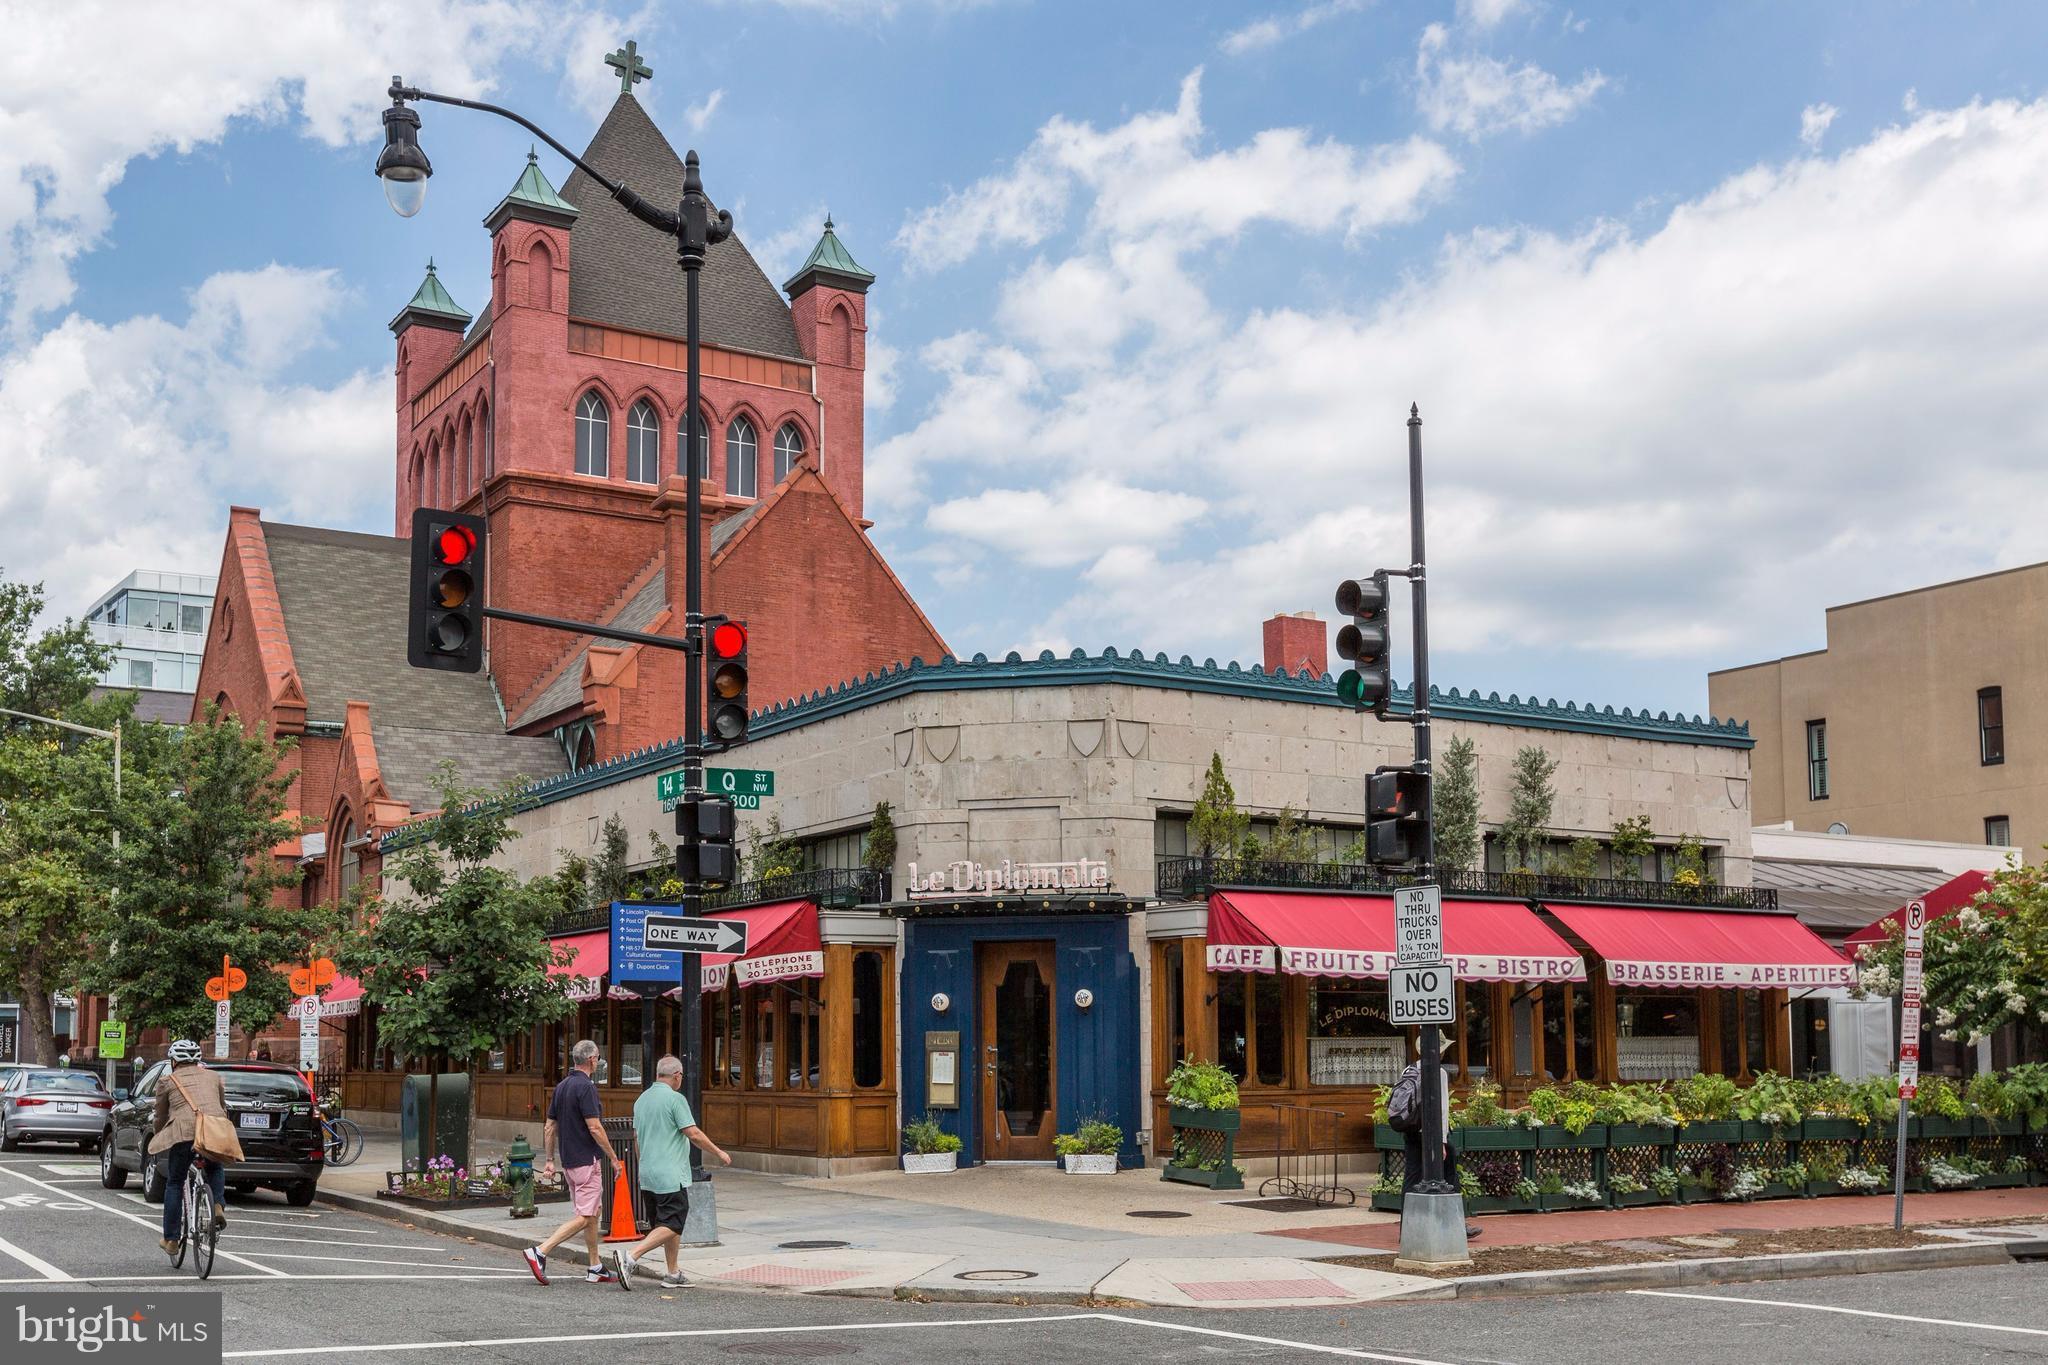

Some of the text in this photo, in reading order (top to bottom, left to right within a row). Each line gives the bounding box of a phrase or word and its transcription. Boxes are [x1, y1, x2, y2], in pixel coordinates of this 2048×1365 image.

[662, 776, 673, 795] 14
[722, 772, 766, 791] Q ST
[753, 784, 768, 792] NW
[908, 857, 1107, 897] Le Diplomate
[1410, 891, 1424, 902] NO
[1405, 904, 1431, 916] THRU
[1399, 915, 1438, 928] TRUCKS
[650, 929, 717, 941] ONE WAY
[1406, 929, 1432, 941] OVER
[1417, 942, 1438, 951] TON
[1290, 952, 1374, 971] FRUITS
[1400, 951, 1438, 961] CAPACITY
[747, 970, 760, 978] 20
[788, 965, 799, 973] 33
[1497, 959, 1573, 976] BISTRO
[1614, 964, 1724, 981] BRASSERIE
[1405, 972, 1438, 993] NO
[336, 1003, 344, 1013] DU
[1394, 998, 1449, 1017] BUSES
[1320, 1006, 1393, 1028] LE DIPLOMAT
